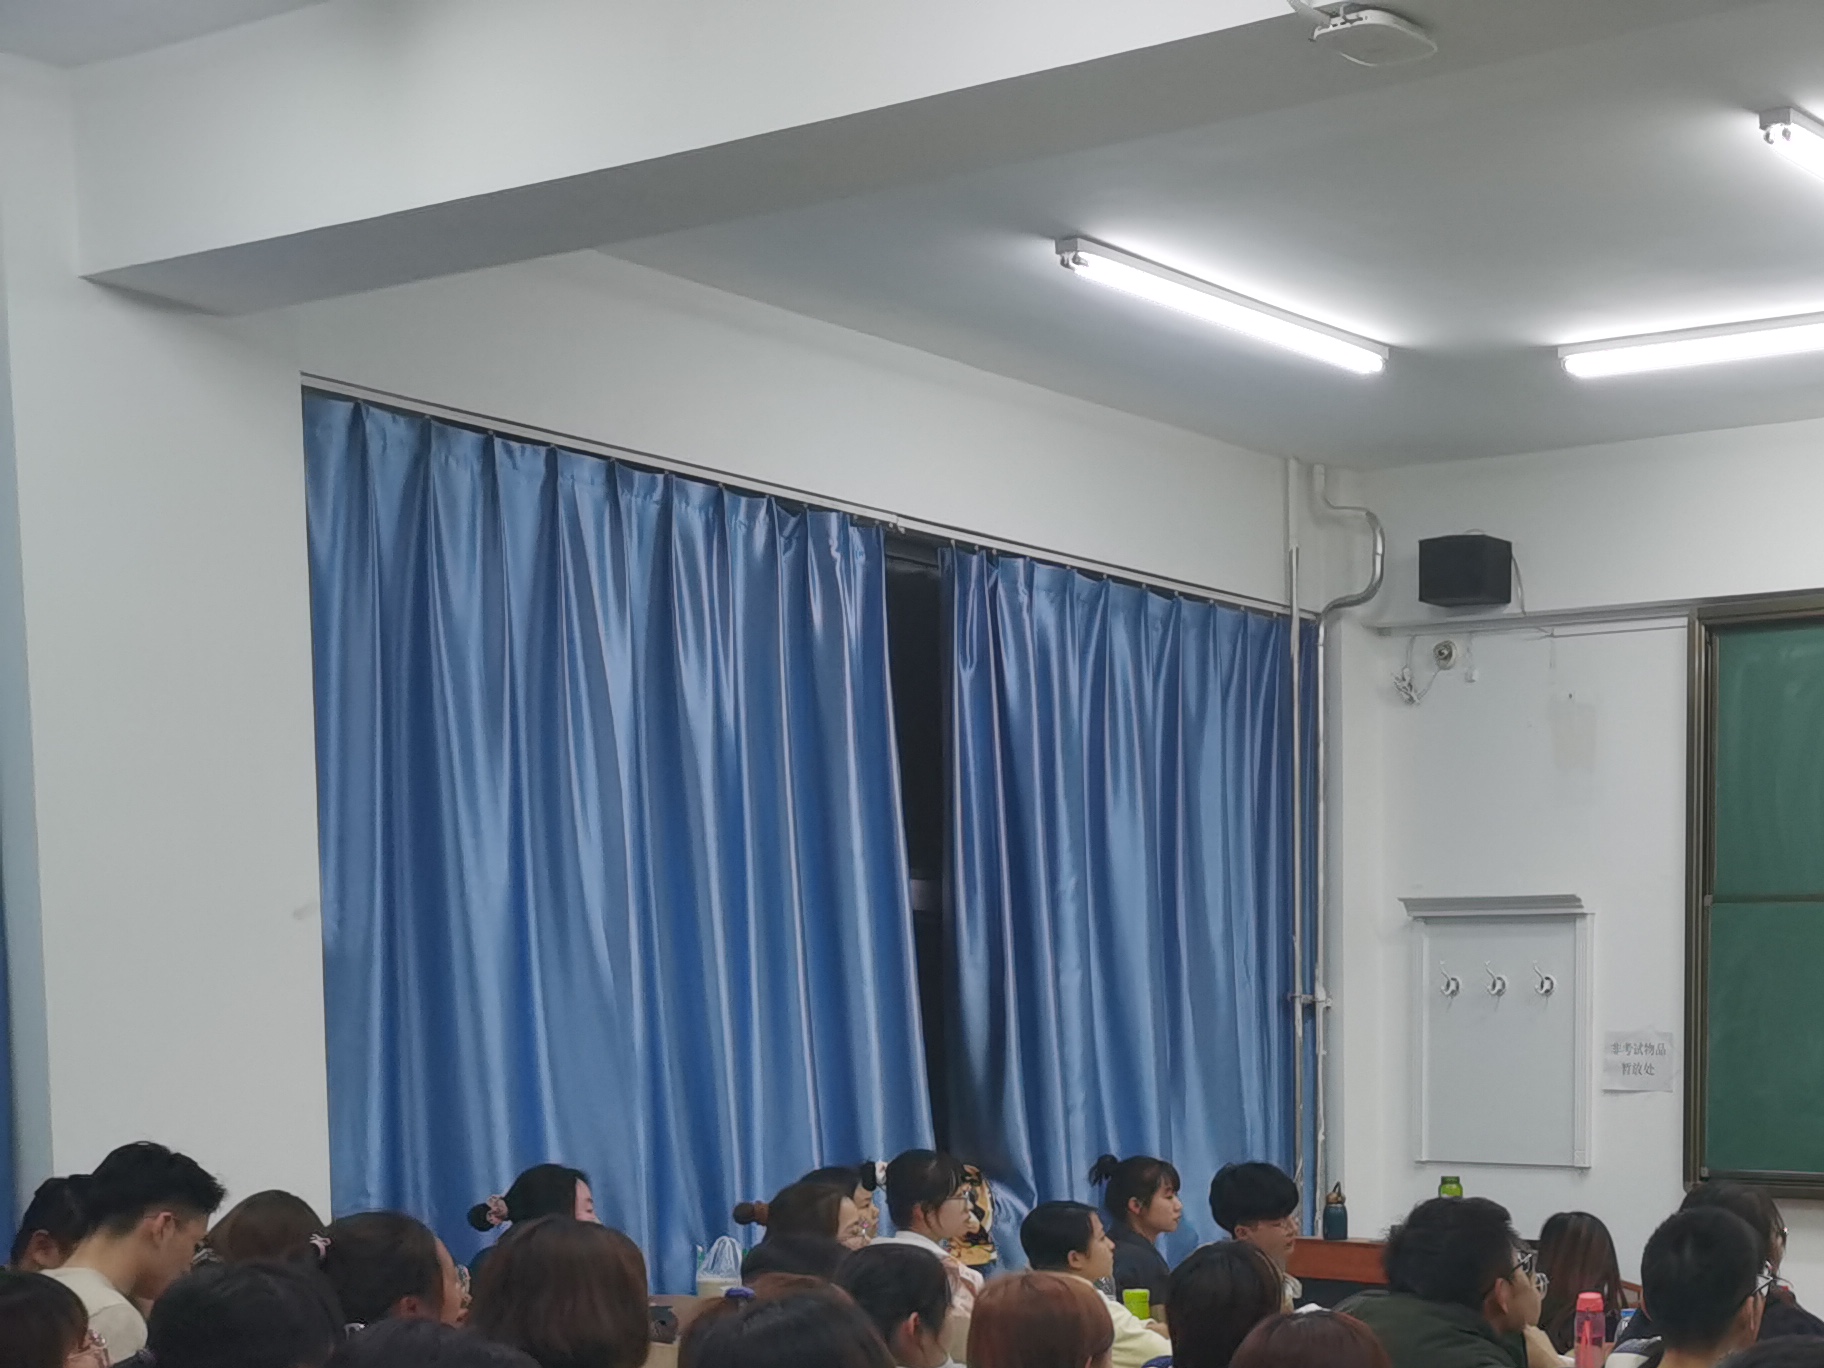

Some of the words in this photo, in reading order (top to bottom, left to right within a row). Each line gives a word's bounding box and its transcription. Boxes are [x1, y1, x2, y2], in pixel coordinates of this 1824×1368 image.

[1611, 1042, 1666, 1056] 非考试物品
[1621, 1062, 1655, 1076] 暂放处
